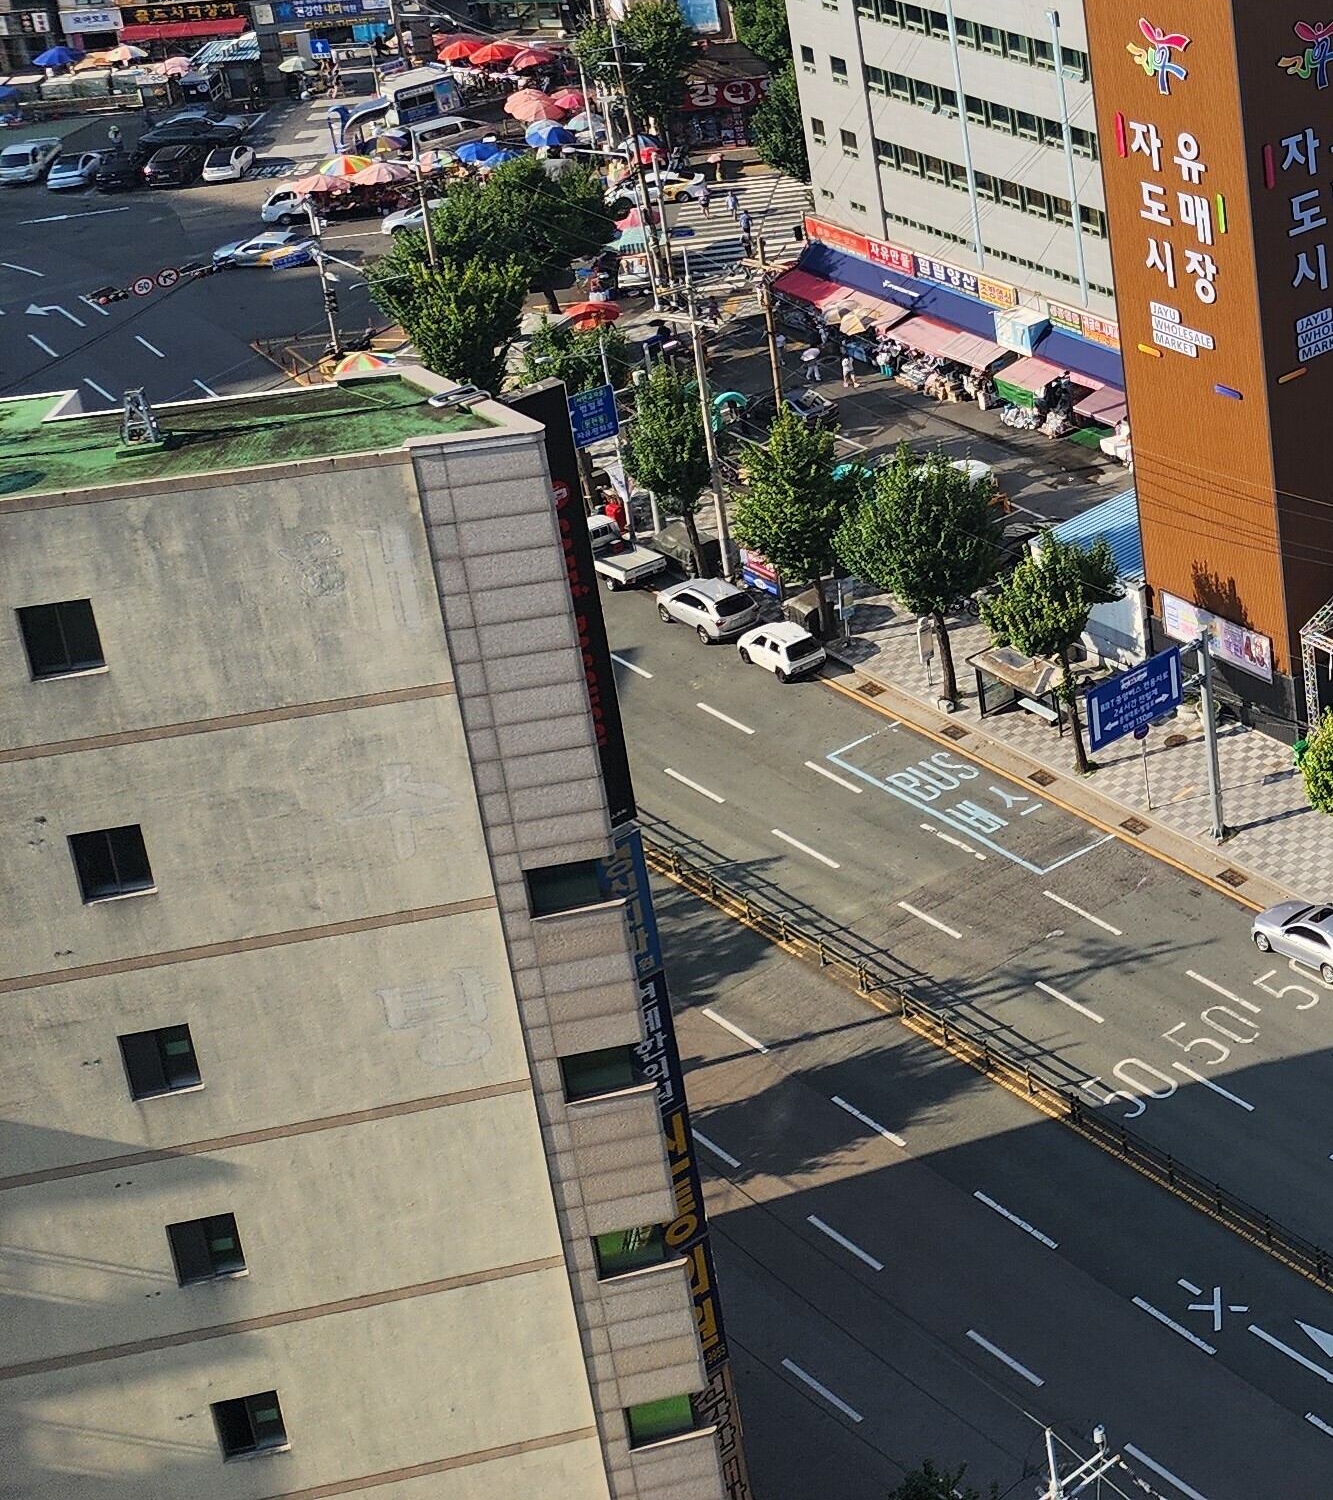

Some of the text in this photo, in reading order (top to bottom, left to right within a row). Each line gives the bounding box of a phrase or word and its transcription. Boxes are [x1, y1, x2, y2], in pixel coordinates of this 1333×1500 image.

[1129, 121, 1206, 185] 자유
[1140, 181, 1213, 246] 도매
[870, 241, 910, 268] 자유만물
[1146, 237, 1219, 305] 시장
[137, 281, 149, 292] 50
[1153, 304, 1177, 321] JAYU
[1299, 310, 1329, 332] JAYU
[1154, 318, 1213, 349] WHOLESALE
[1155, 332, 1197, 354] MARKET
[885, 751, 981, 802] BUS
[944, 785, 1043, 835] 버스
[1080, 1057, 1178, 1118] 50
[1162, 1005, 1260, 1065] 50
